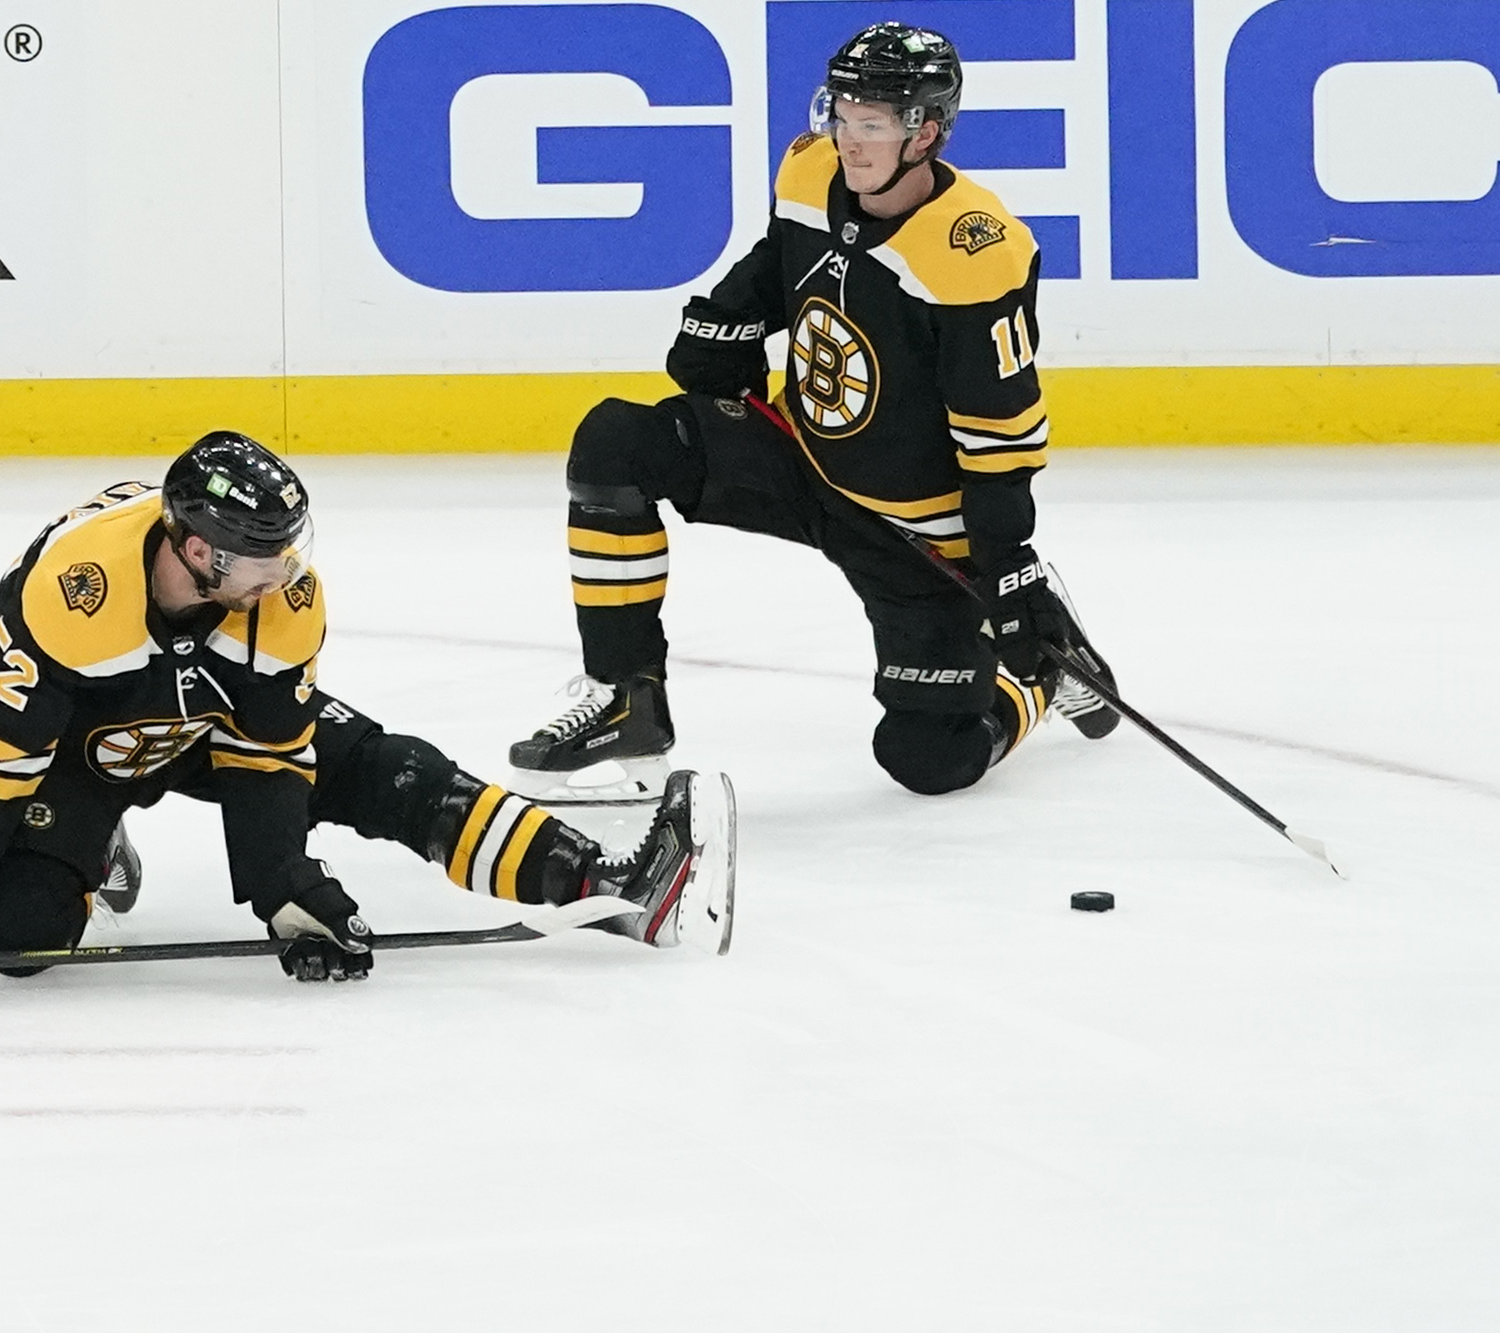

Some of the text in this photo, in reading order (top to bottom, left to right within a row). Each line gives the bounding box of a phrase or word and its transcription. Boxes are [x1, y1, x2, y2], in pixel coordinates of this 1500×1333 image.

[683, 314, 767, 343] BAUER
[991, 306, 1035, 380] 11
[807, 330, 848, 409] B
[229, 487, 258, 510] Bank
[999, 561, 1048, 596] BAU
[882, 665, 975, 684] BAUER
